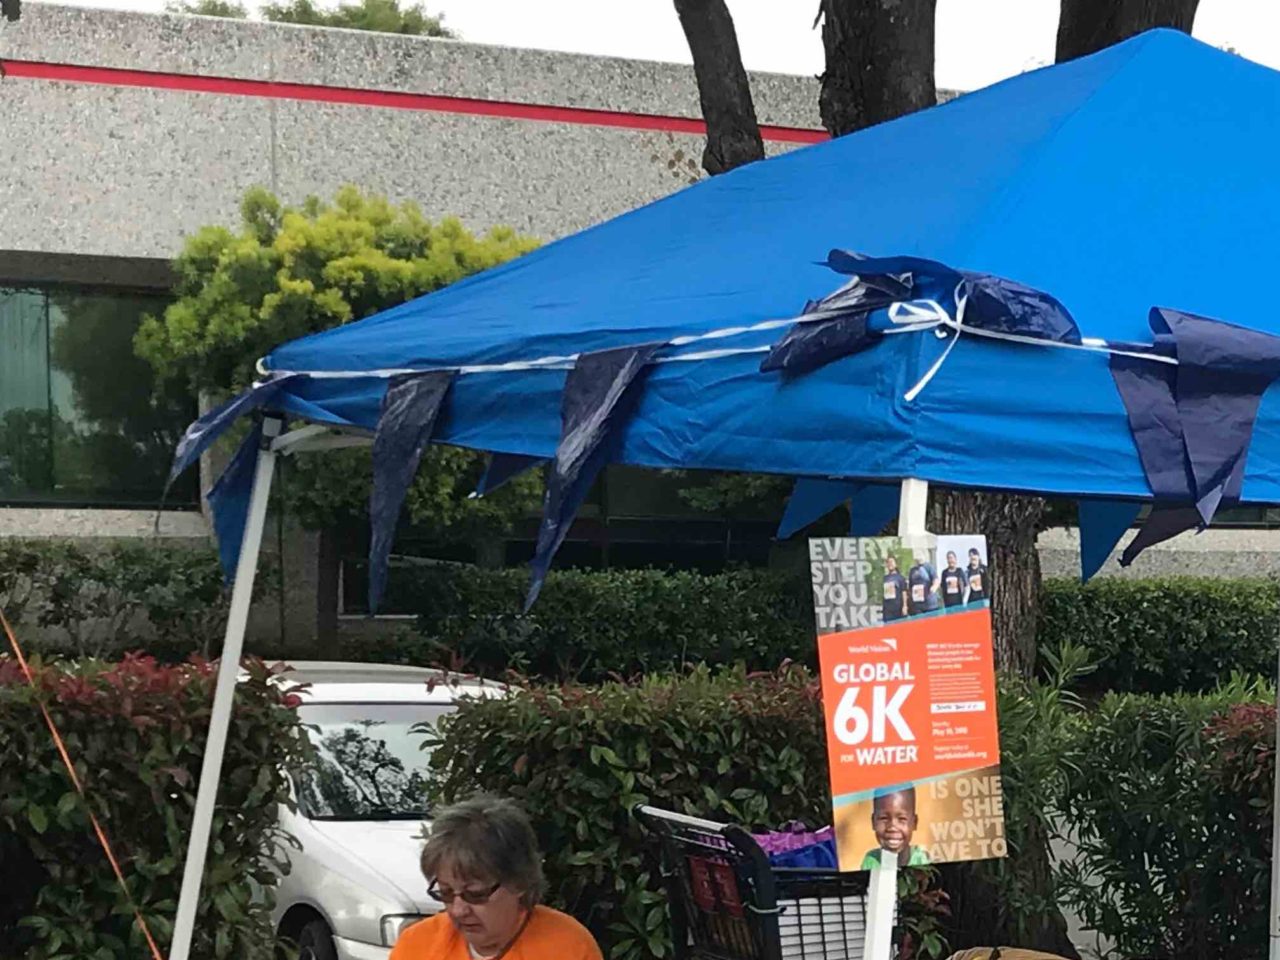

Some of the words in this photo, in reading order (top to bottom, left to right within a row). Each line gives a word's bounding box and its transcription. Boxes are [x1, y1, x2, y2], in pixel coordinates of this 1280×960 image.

[808, 536, 896, 561] EVERY
[811, 560, 872, 583] STEP
[812, 583, 868, 606] YOU
[815, 604, 884, 628] TAKE
[833, 661, 915, 684] GLOBAL
[833, 684, 916, 745] 6K
[856, 745, 918, 766] WATER
[929, 781, 949, 799] IS
[955, 776, 1002, 797] ONE
[962, 796, 1004, 818] SHE
[929, 817, 1005, 841] WON'T
[977, 838, 1007, 858] TO
